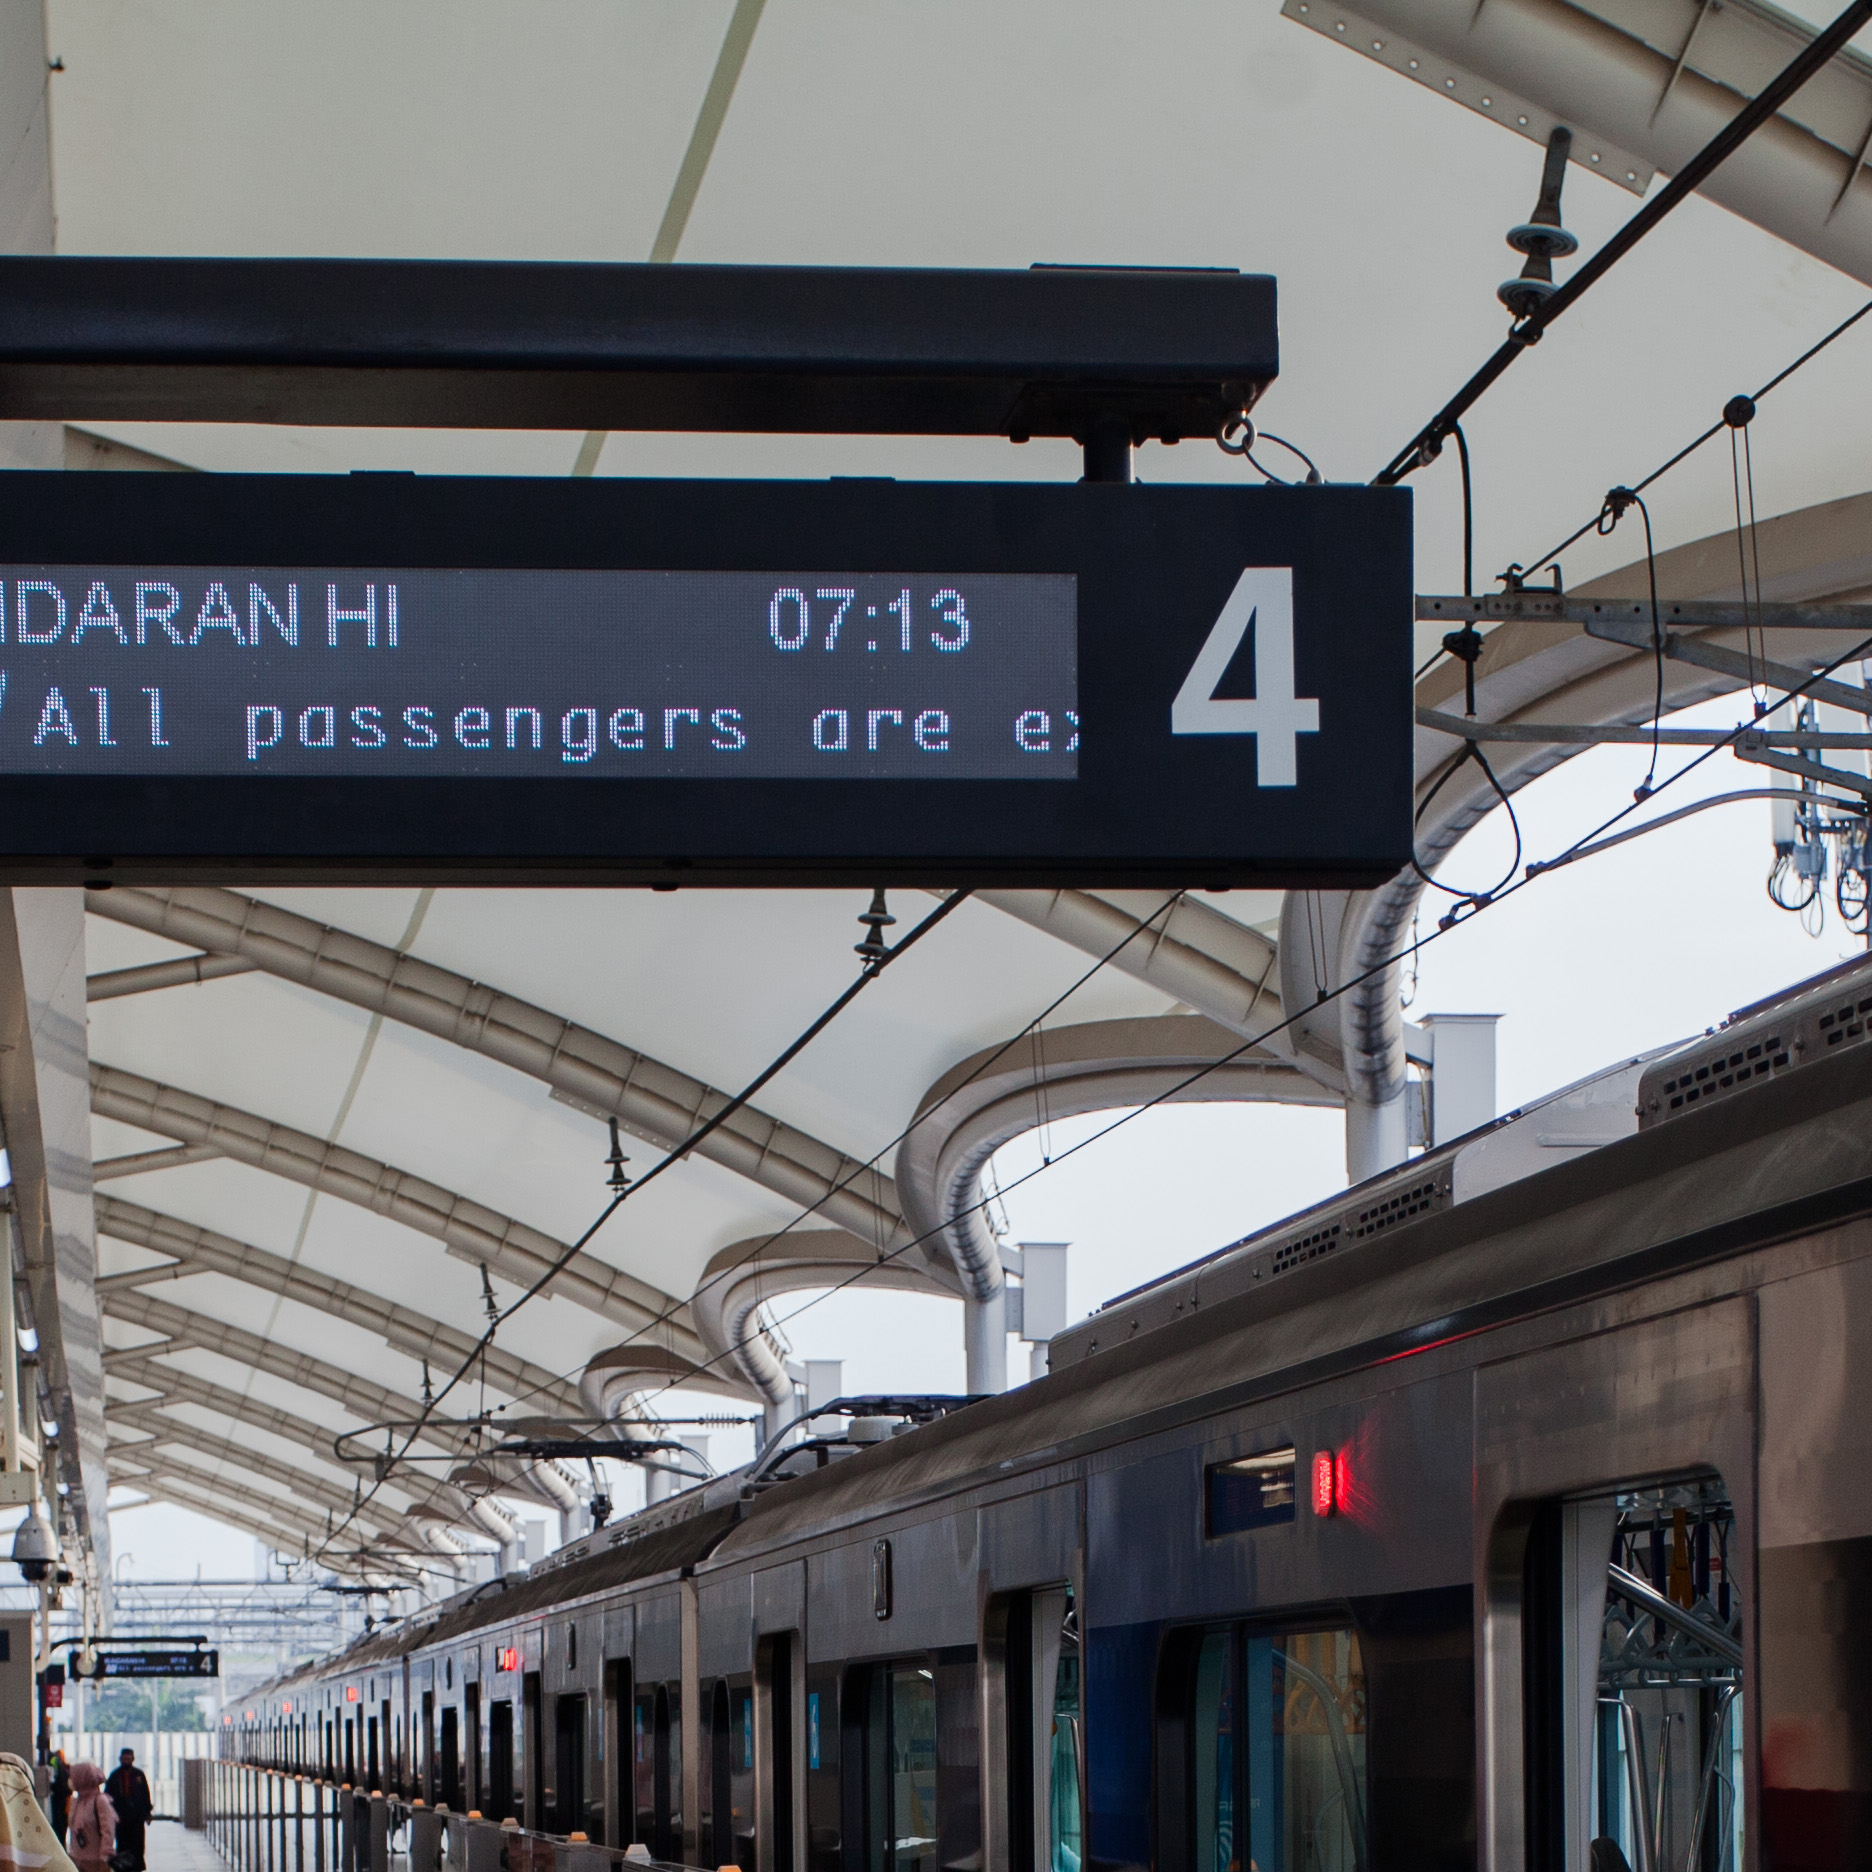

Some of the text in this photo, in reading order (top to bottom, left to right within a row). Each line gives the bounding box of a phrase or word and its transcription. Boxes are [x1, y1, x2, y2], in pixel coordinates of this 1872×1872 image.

[327, 583, 400, 649] HI
[769, 587, 972, 652] 07:13
[1171, 566, 1322, 789] 4
[33, 687, 171, 750] All
[246, 705, 748, 765] passengers
[812, 709, 951, 753] are
[200, 1655, 212, 1674] 4
